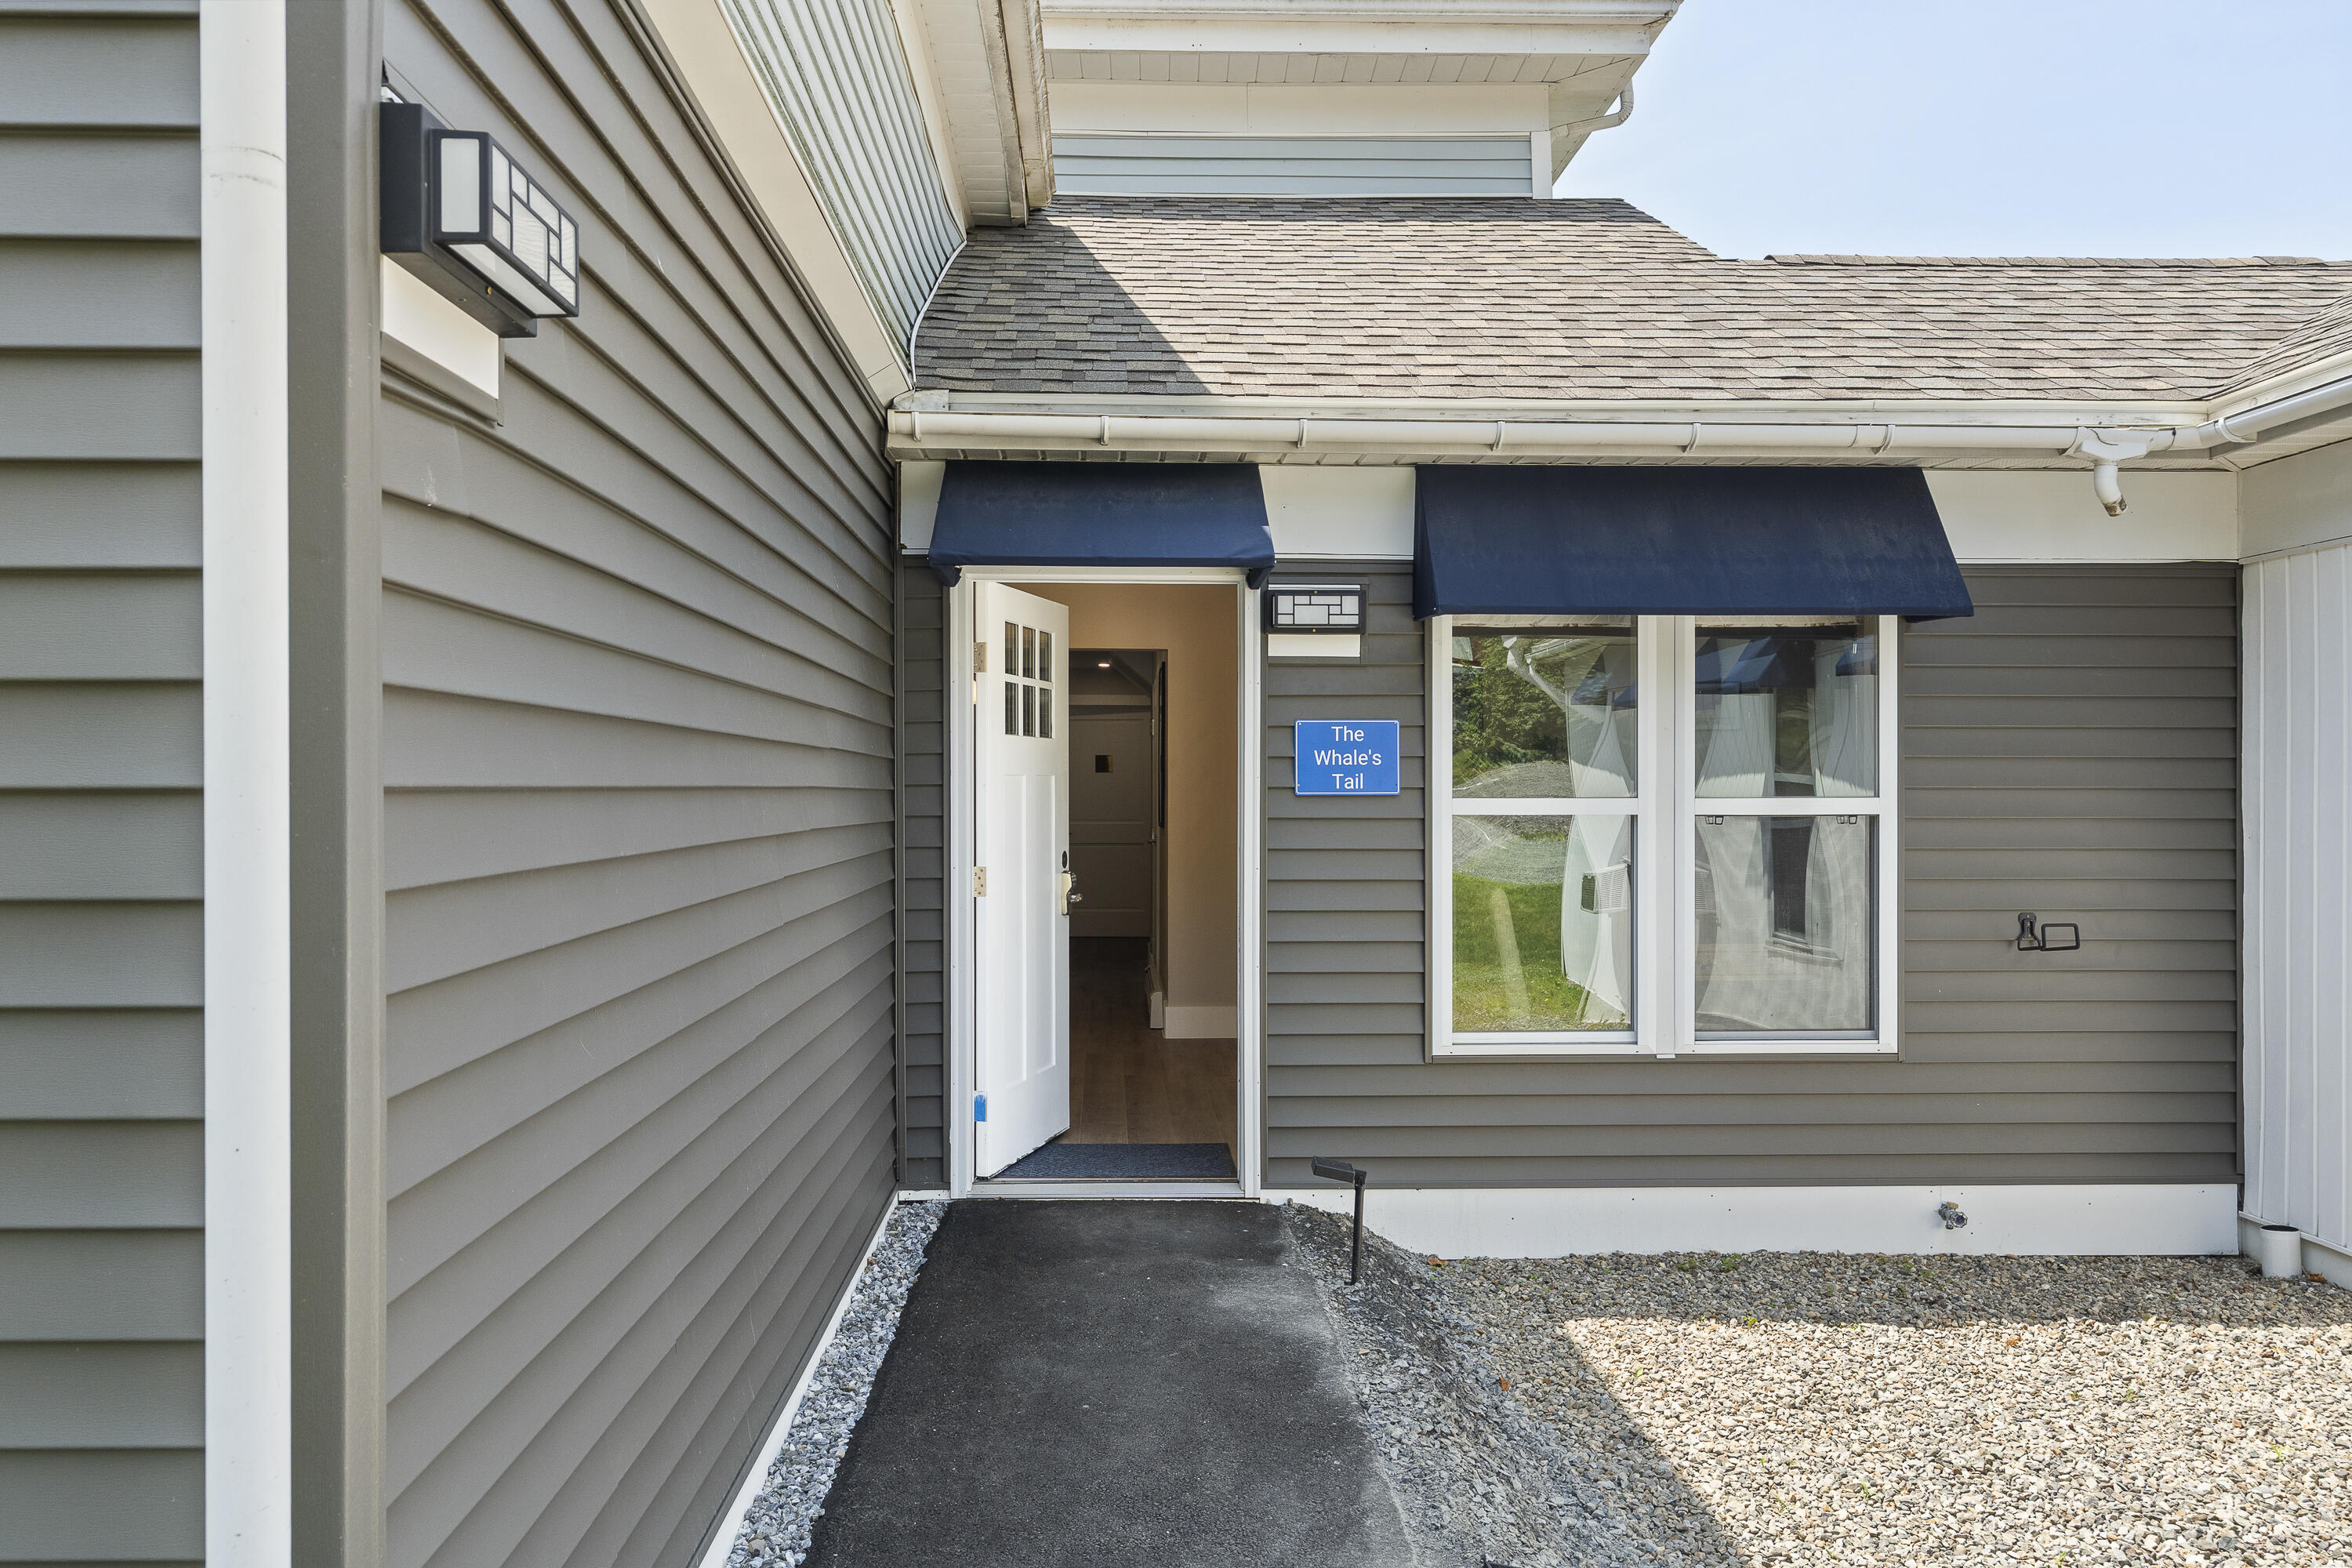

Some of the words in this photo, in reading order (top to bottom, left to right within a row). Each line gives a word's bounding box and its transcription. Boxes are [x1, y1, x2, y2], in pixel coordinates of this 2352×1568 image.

[1331, 725, 1364, 742] The
[1314, 749, 1382, 765] Whale's
[1331, 772, 1363, 789] Tail
